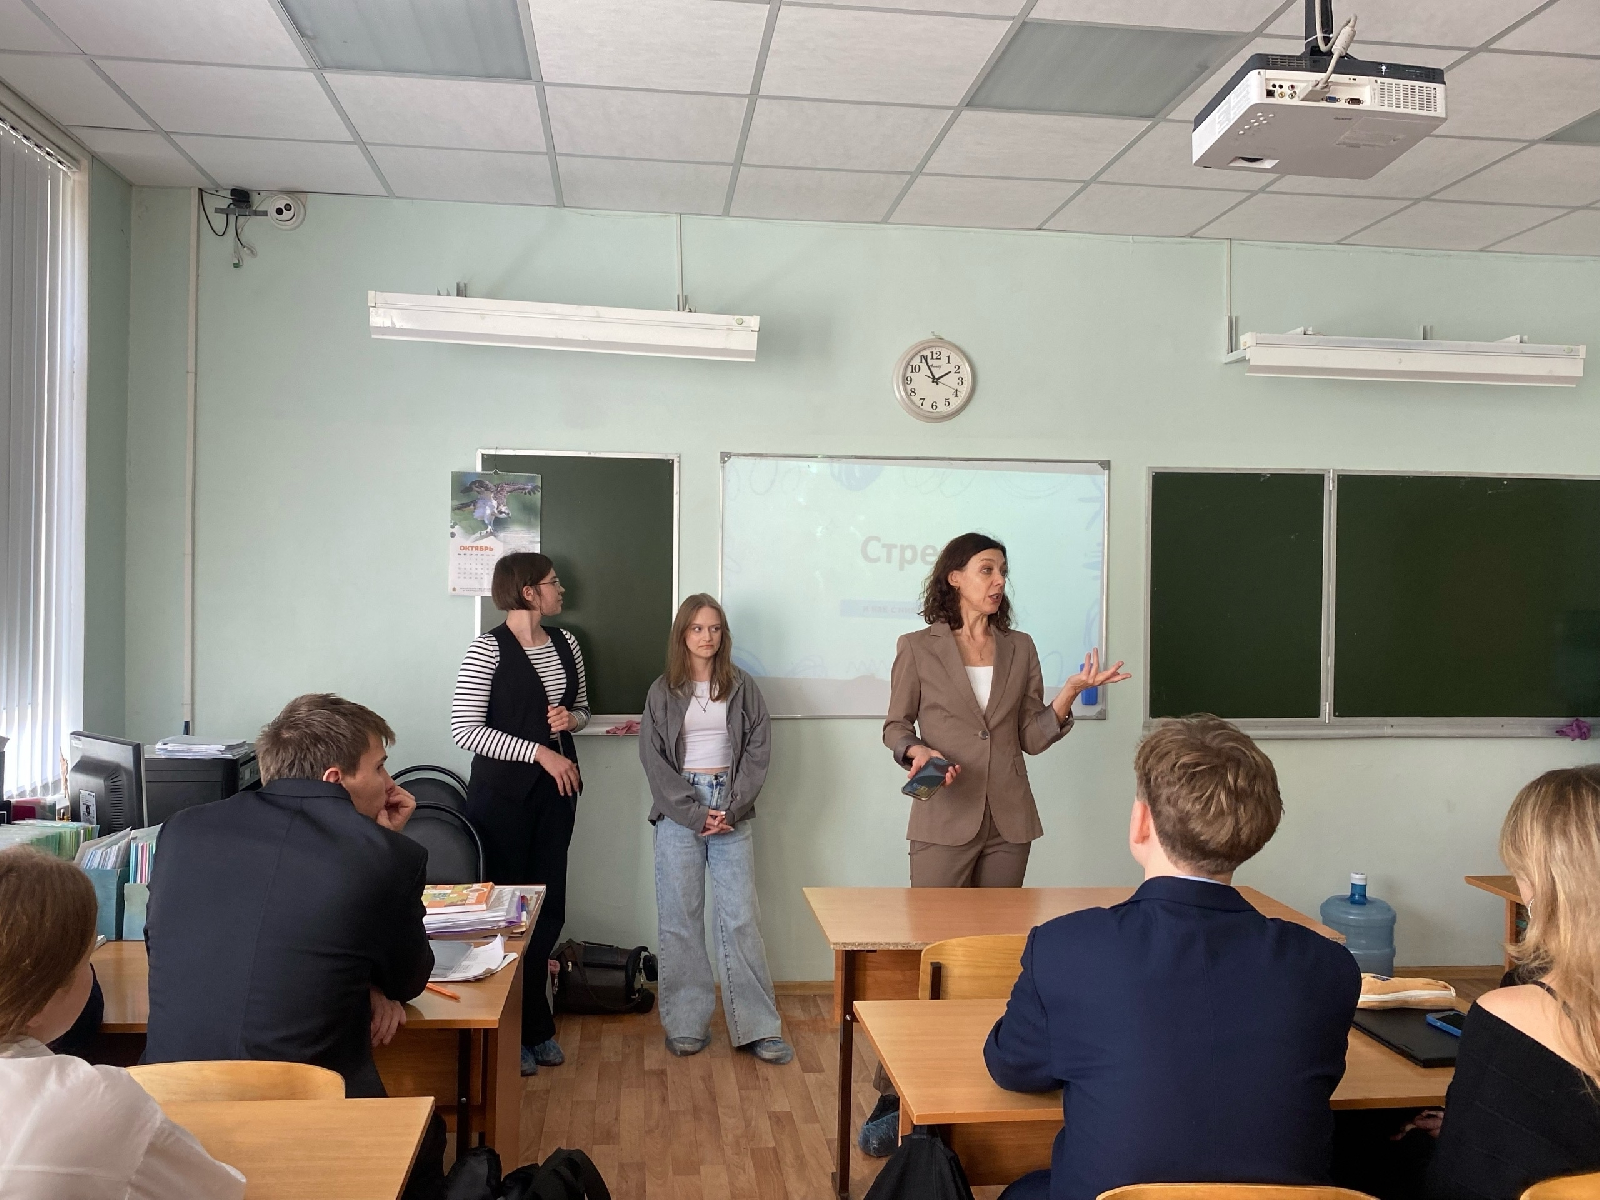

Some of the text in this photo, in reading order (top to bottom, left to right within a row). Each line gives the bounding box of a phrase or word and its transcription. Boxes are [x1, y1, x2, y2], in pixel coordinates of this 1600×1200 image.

[930, 350, 942, 360] 12
[946, 355, 951, 364] 1
[910, 364, 921, 373] 10
[954, 365, 960, 373] 2
[906, 376, 912, 385] 9
[957, 377, 963, 386] 3
[909, 388, 916, 396] 8
[952, 388, 958, 397] 4
[919, 398, 925, 406] 7
[931, 401, 938, 410] 6
[944, 398, 950, 406] 5
[861, 535, 939, 571] Стре
